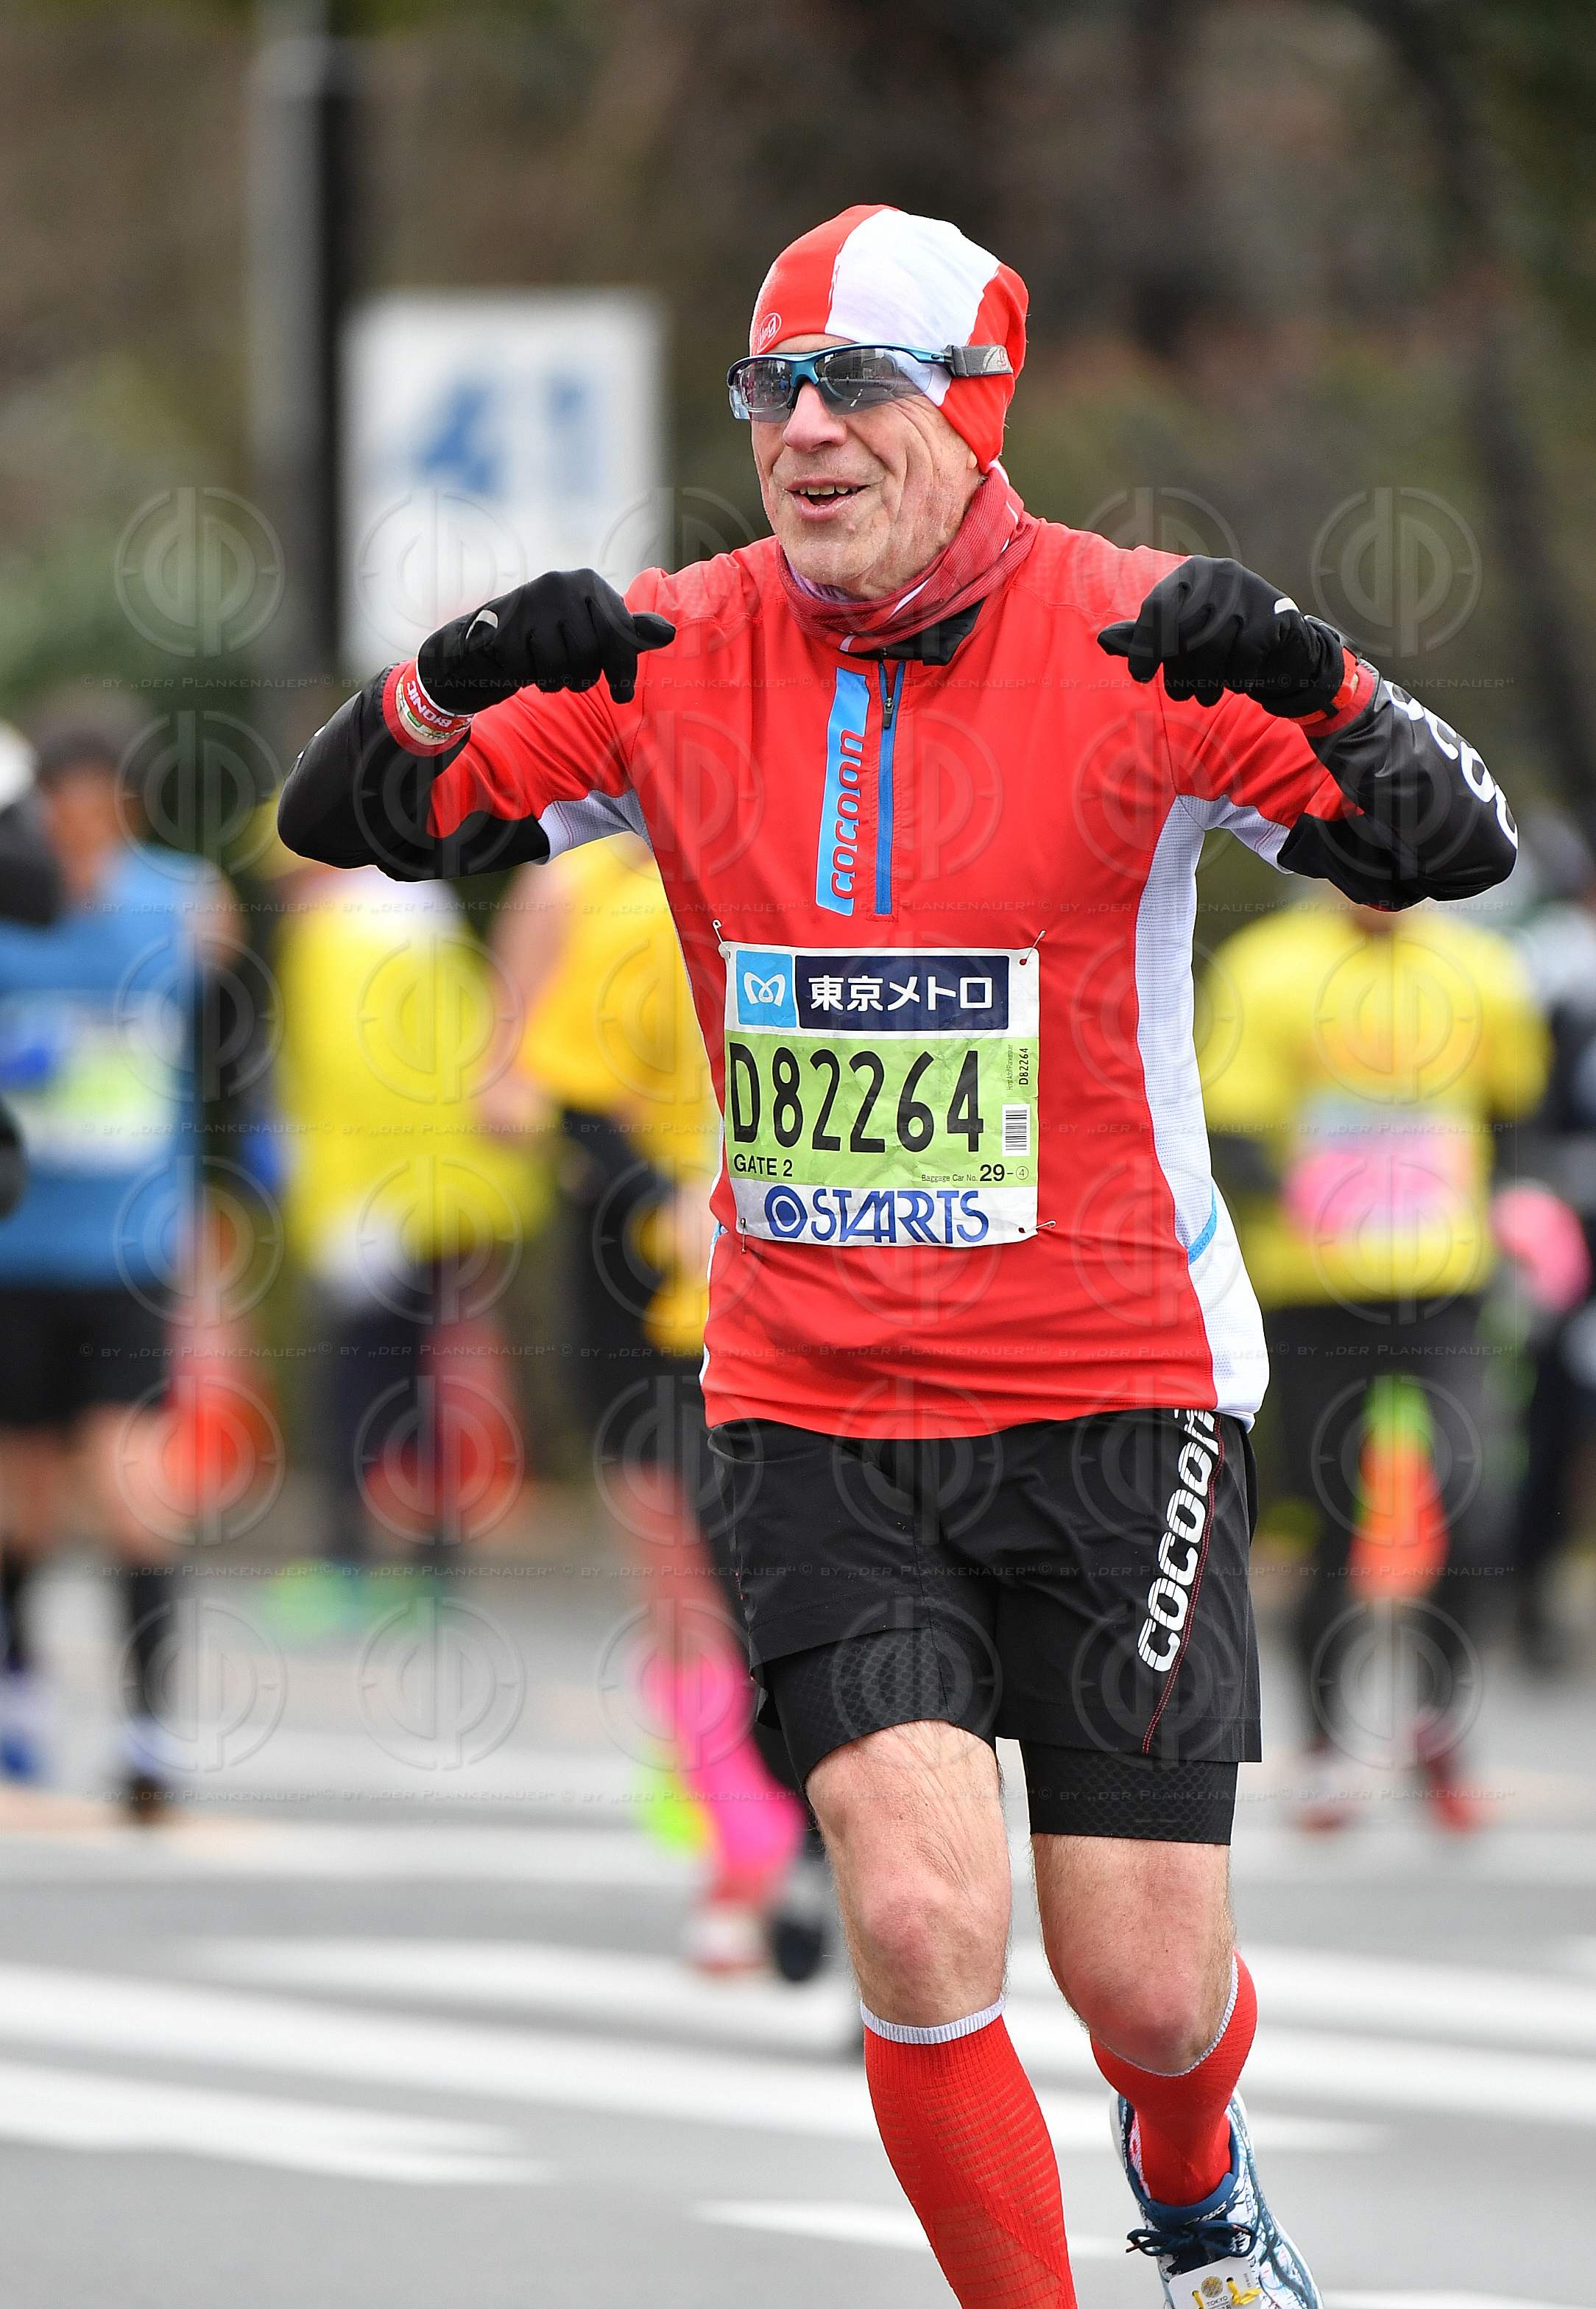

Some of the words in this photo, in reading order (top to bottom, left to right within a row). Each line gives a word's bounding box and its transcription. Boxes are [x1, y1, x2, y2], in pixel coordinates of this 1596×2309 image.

[830, 728, 865, 900] cocoon
[808, 975, 992, 1011] 東京メトロ
[1018, 1047, 1029, 1085] D82264
[730, 1043, 984, 1152] D82264
[734, 1153, 777, 1176] GATE
[783, 1159, 793, 1177] 2
[921, 1174, 950, 1182] Baggage
[811, 1188, 989, 1244] STARTS
